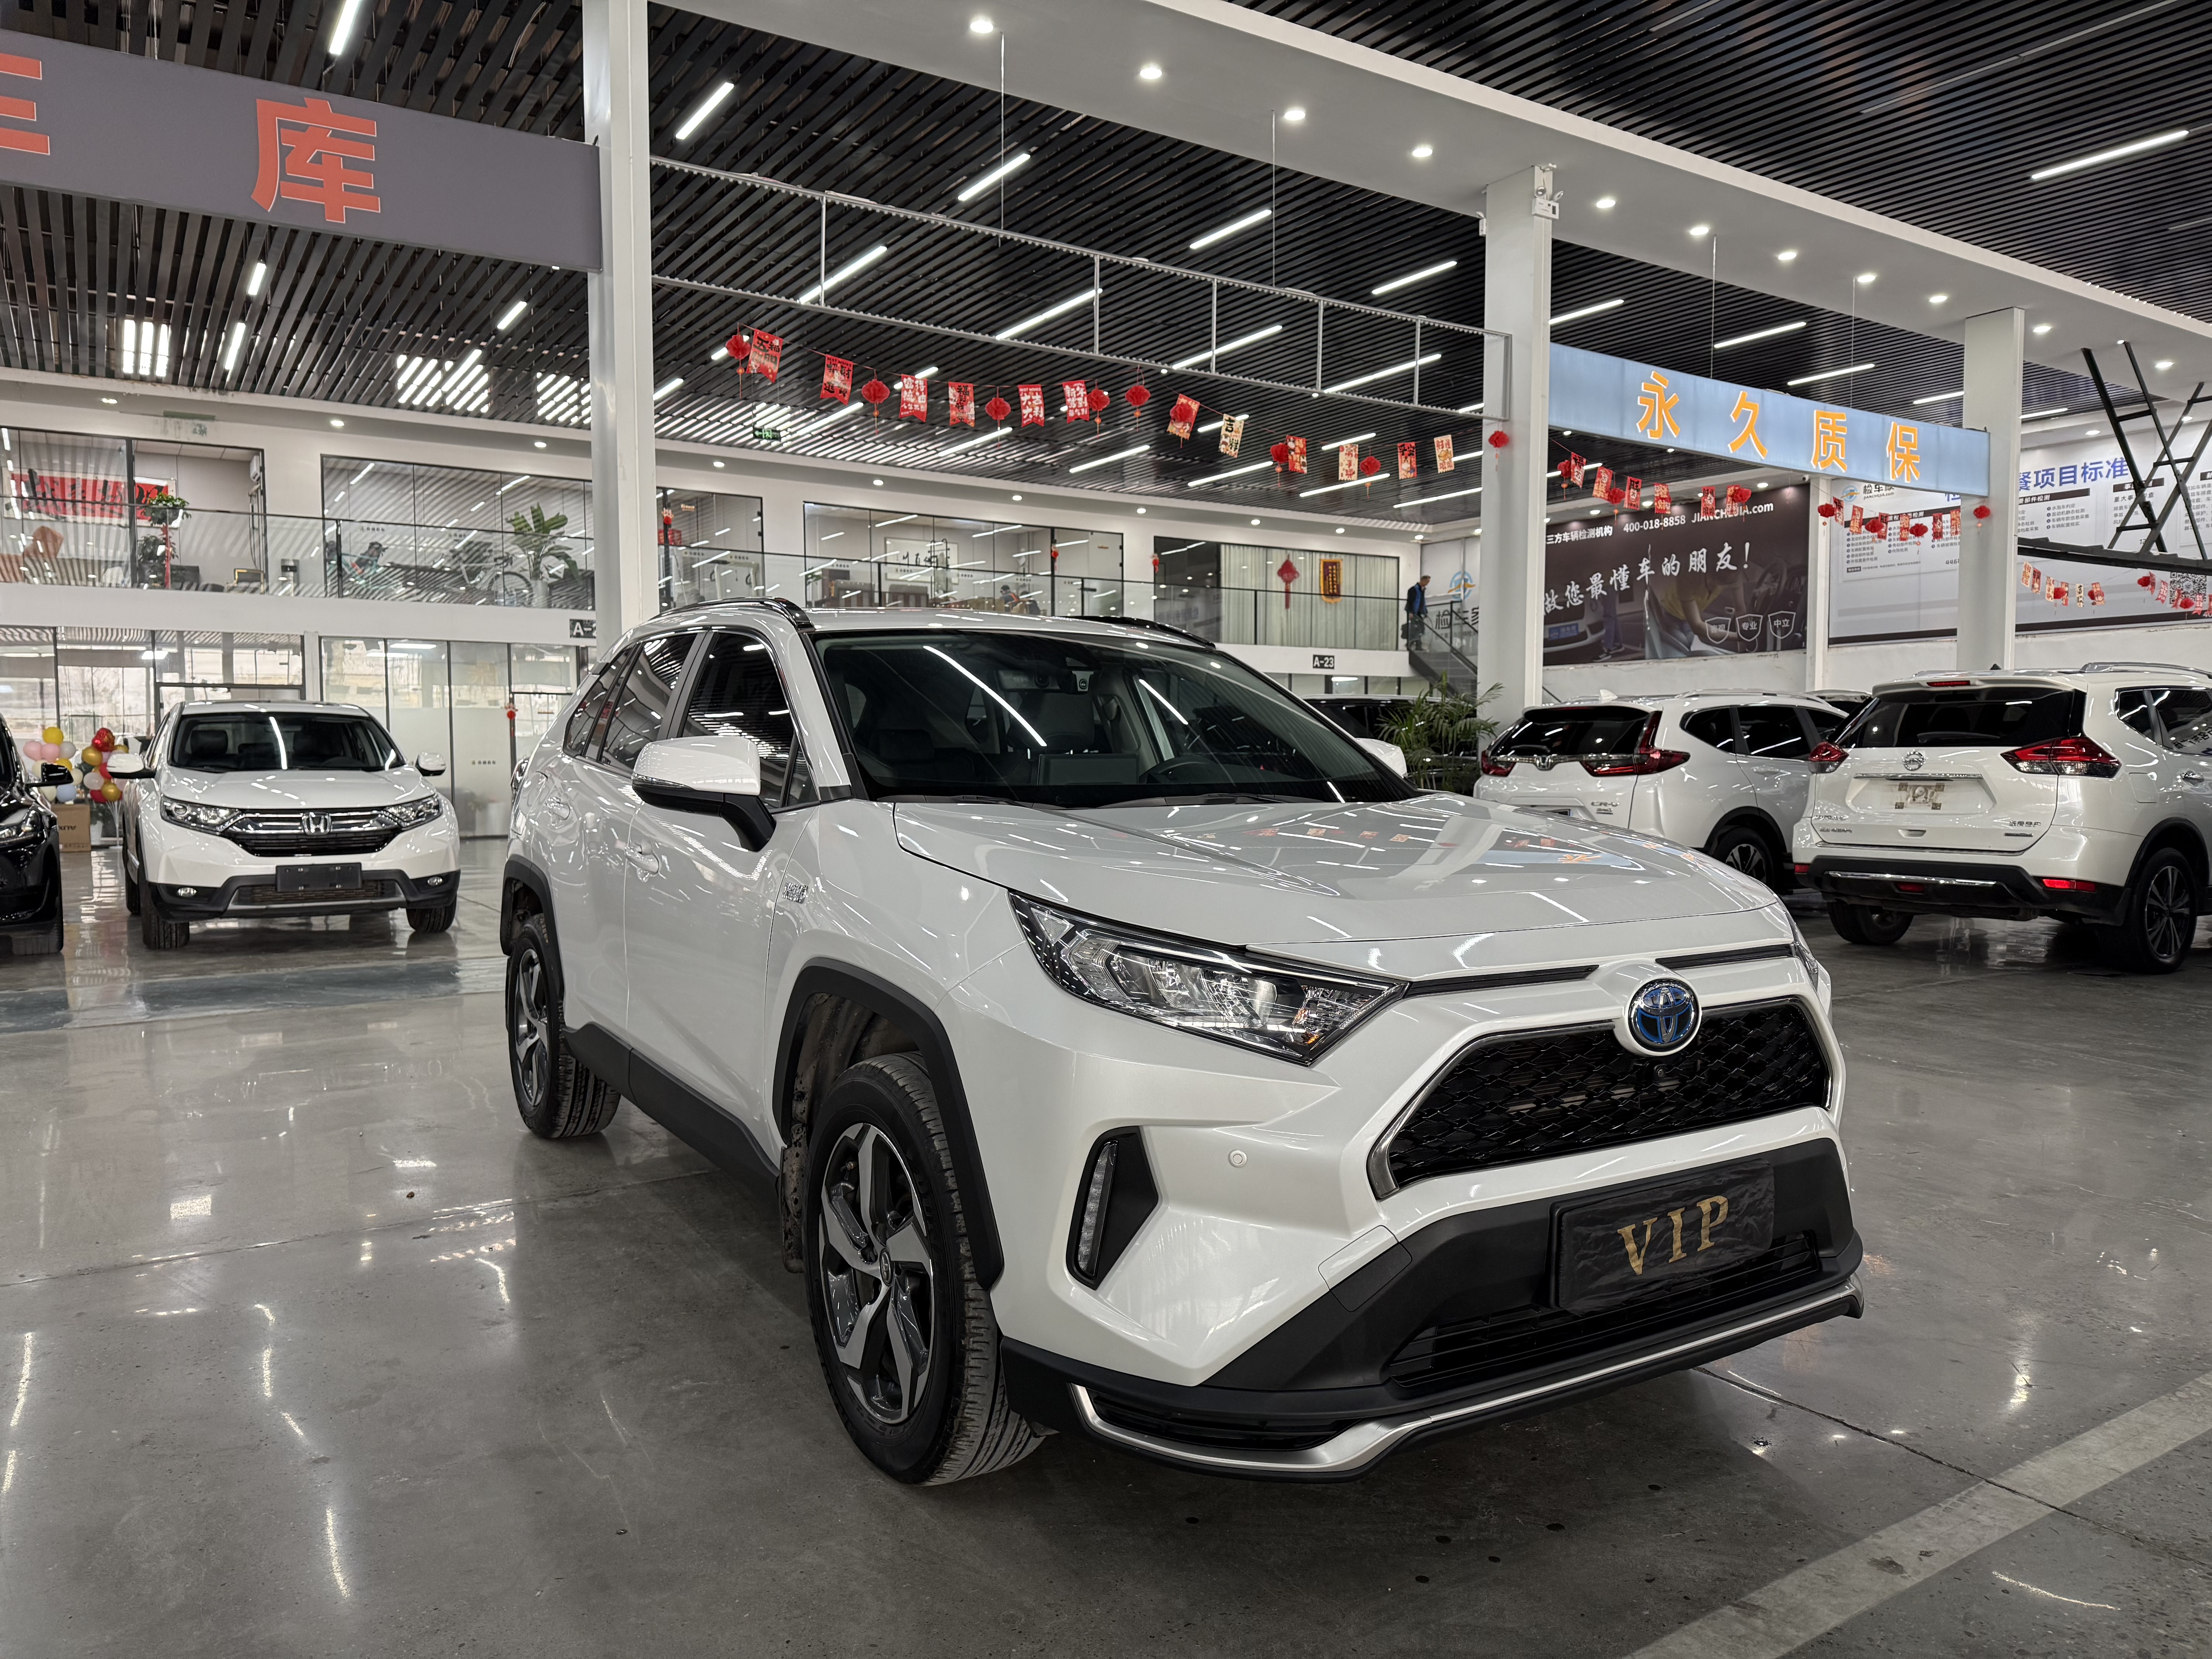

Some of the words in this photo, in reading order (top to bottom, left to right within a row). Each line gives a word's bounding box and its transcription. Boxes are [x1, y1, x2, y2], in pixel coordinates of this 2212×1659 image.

[1636, 371, 1920, 483] 永久质保
[1399, 444, 1415, 456] 平安
[1546, 525, 1613, 544] 三方车辆检测机构
[1623, 515, 1686, 533] 400-018-8858
[1741, 621, 1757, 630] 专业
[1774, 618, 1790, 628] 中立
[1313, 656, 1334, 668] A-23
[1617, 1195, 1729, 1276] VIP
